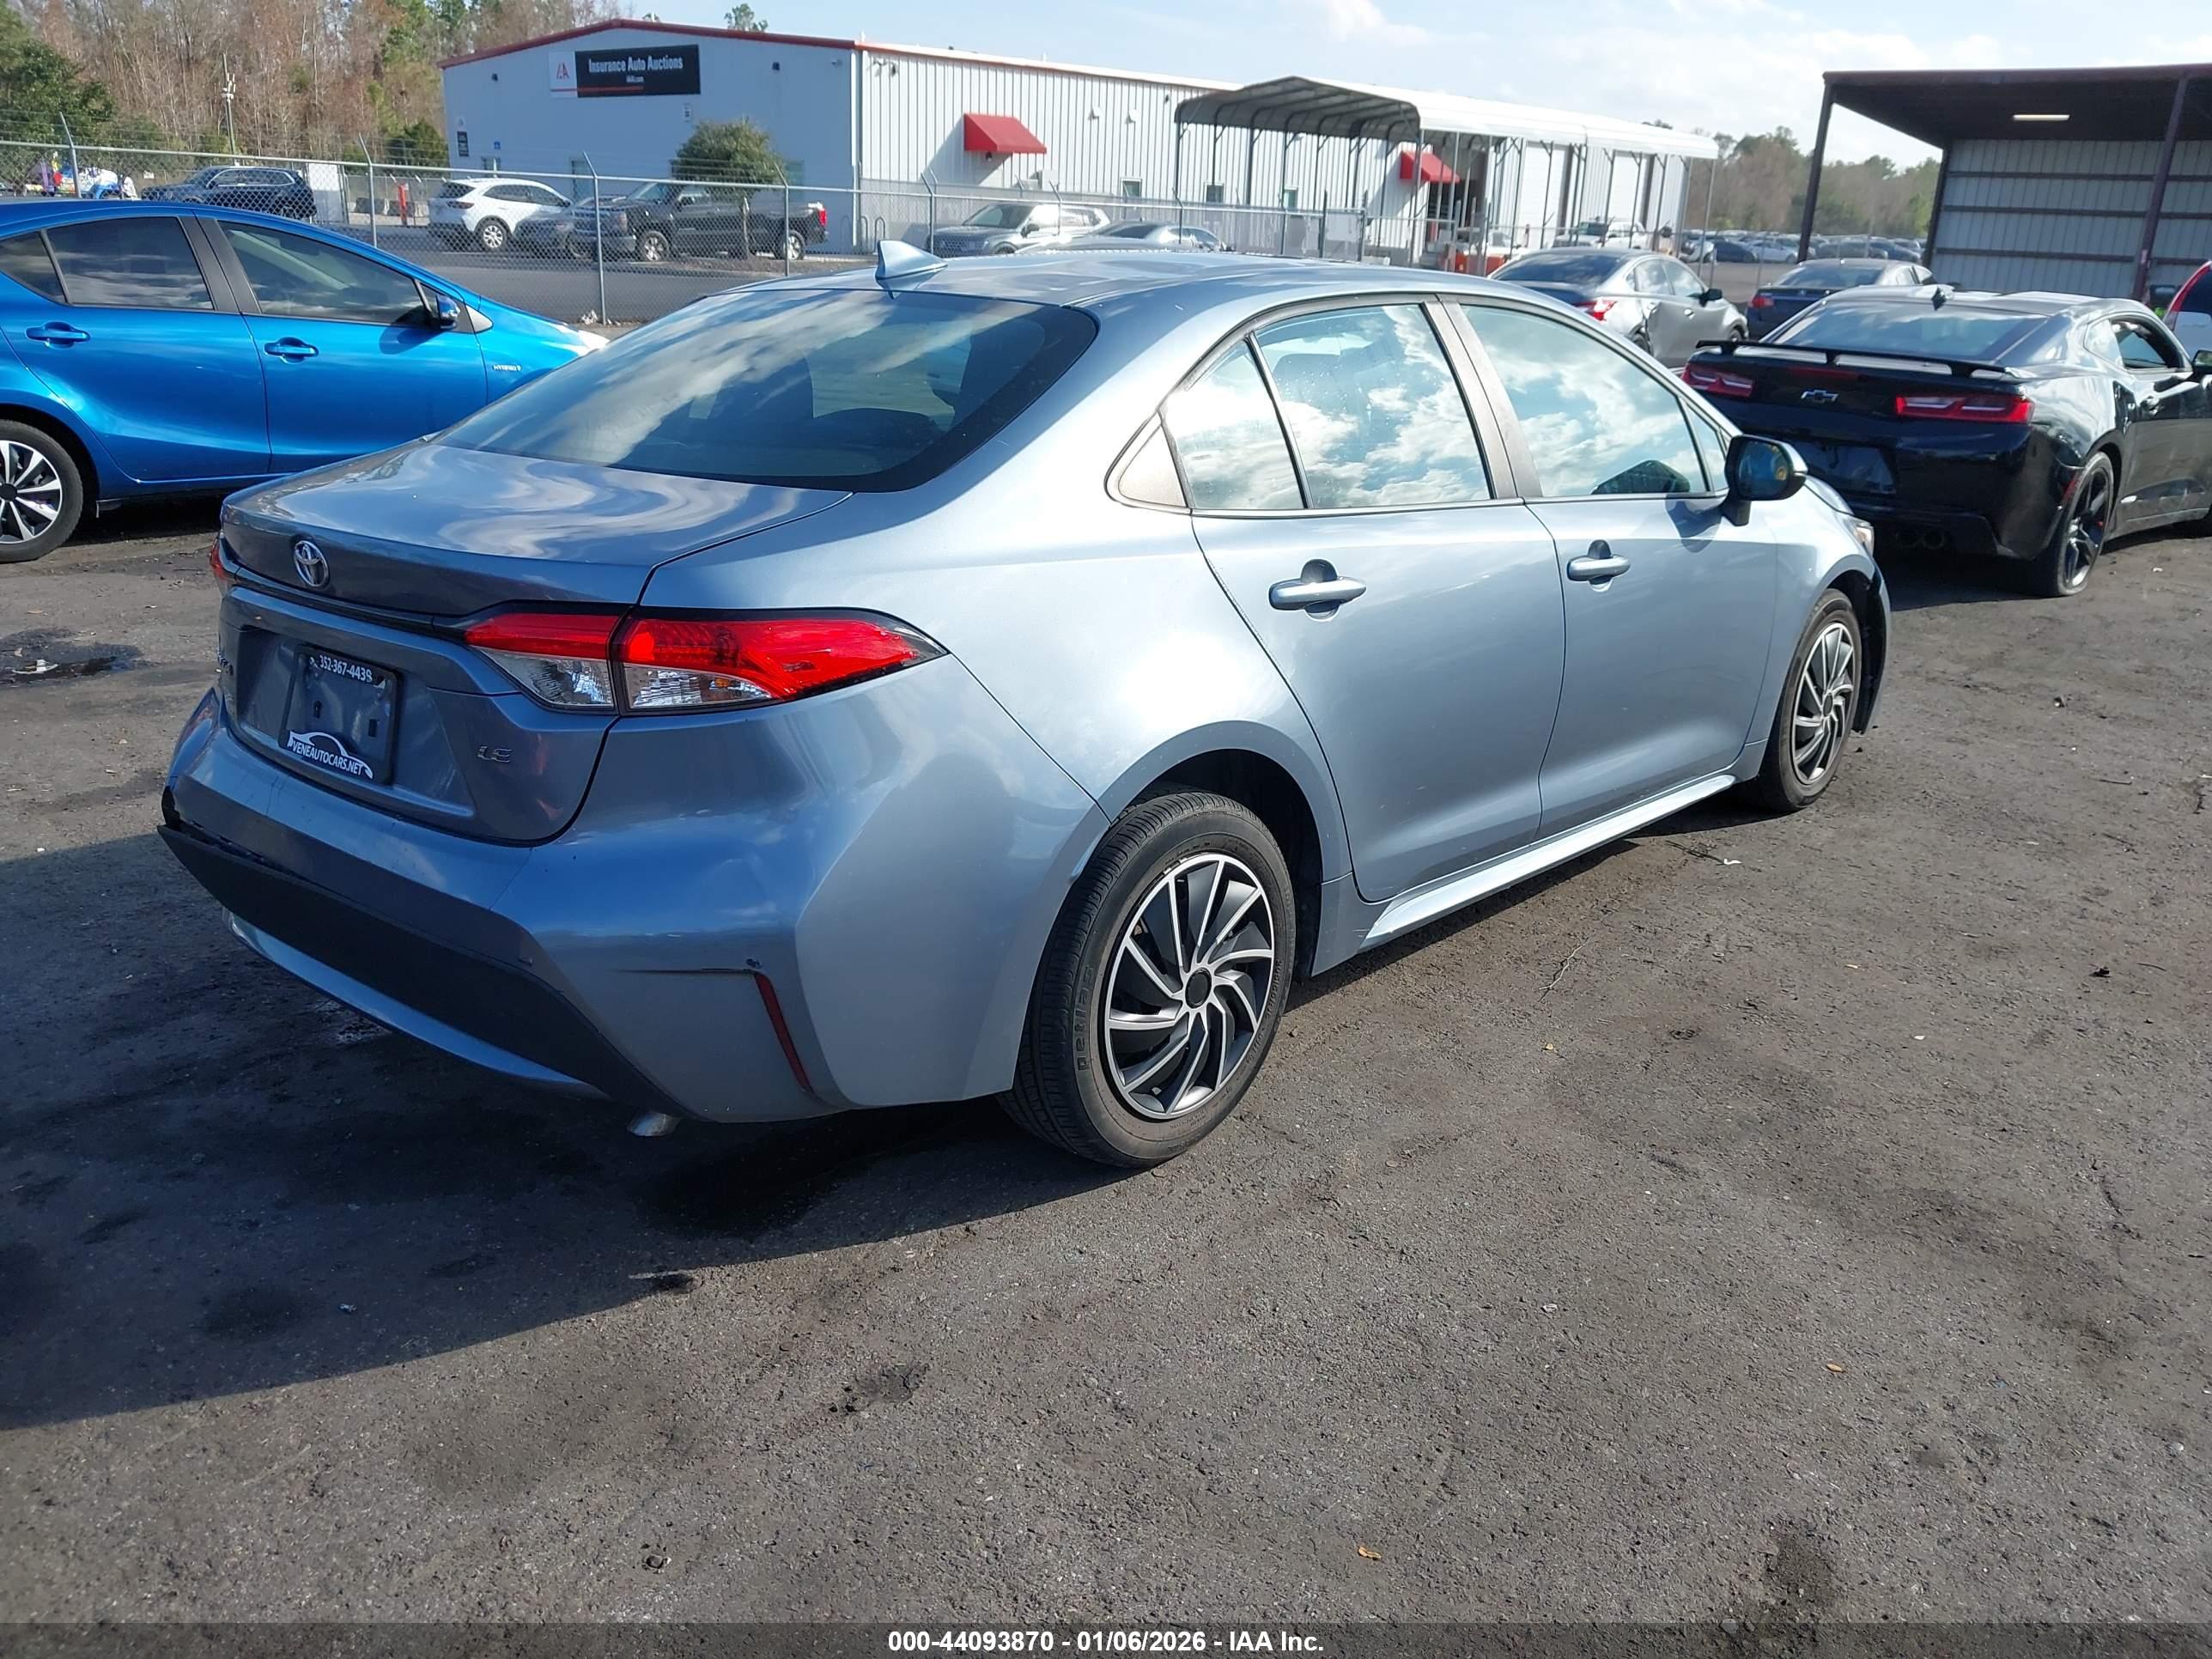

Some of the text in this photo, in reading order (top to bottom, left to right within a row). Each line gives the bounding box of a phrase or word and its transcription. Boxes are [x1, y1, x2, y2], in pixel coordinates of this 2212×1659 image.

[589, 55, 684, 73] Insurance Auto Auctions
[293, 744, 362, 775] VENEAUTOCARS.NET
